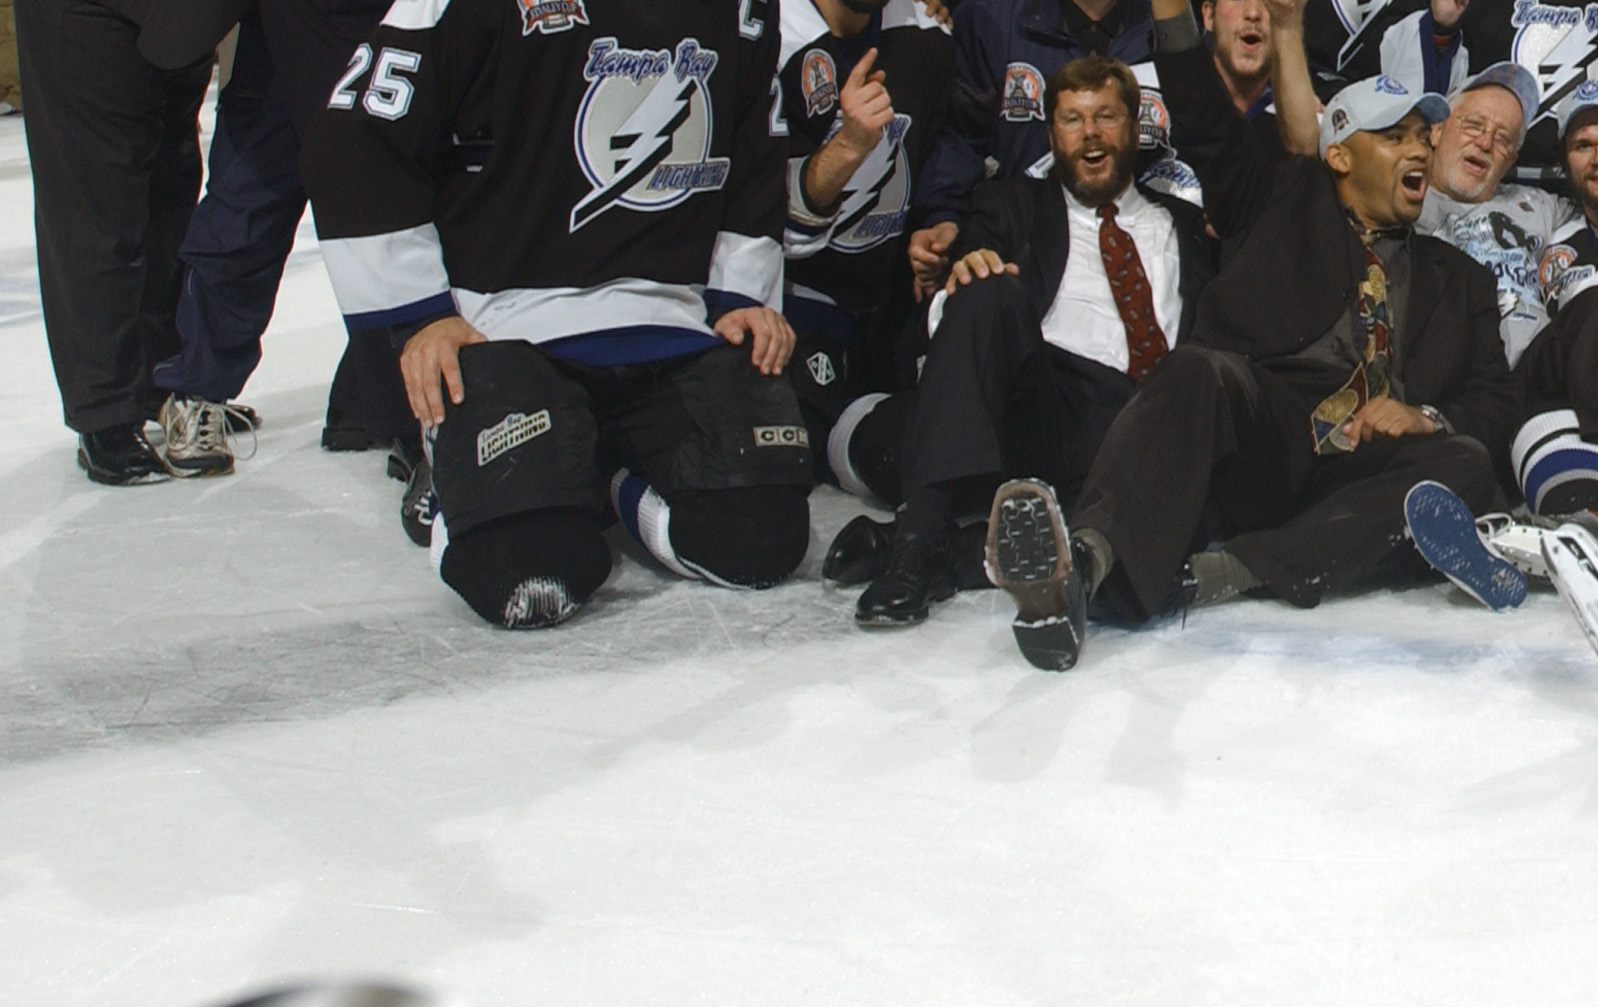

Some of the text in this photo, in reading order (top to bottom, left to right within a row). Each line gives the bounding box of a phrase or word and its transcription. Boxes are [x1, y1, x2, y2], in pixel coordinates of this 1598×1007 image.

[327, 42, 422, 124] 25
[585, 38, 718, 85] Tampa Bay
